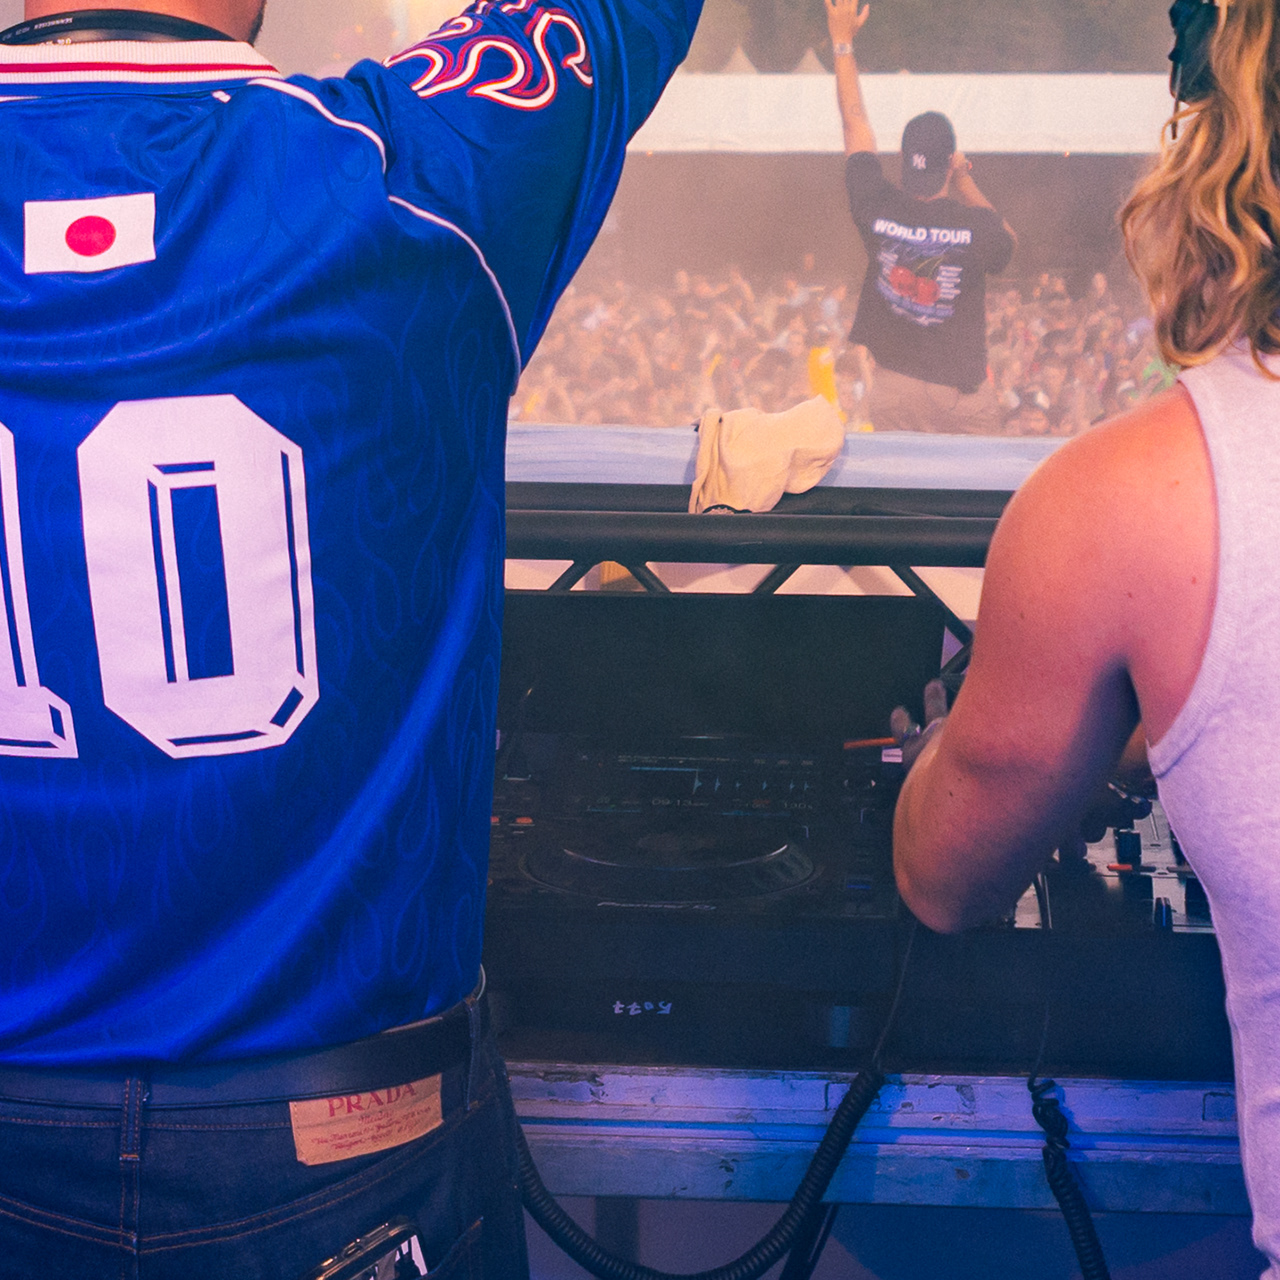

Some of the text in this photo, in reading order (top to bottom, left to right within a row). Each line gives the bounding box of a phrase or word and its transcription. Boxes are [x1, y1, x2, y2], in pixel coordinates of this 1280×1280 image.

[873, 219, 972, 245] WORLD TOUR
[327, 1083, 417, 1118] PRADA
